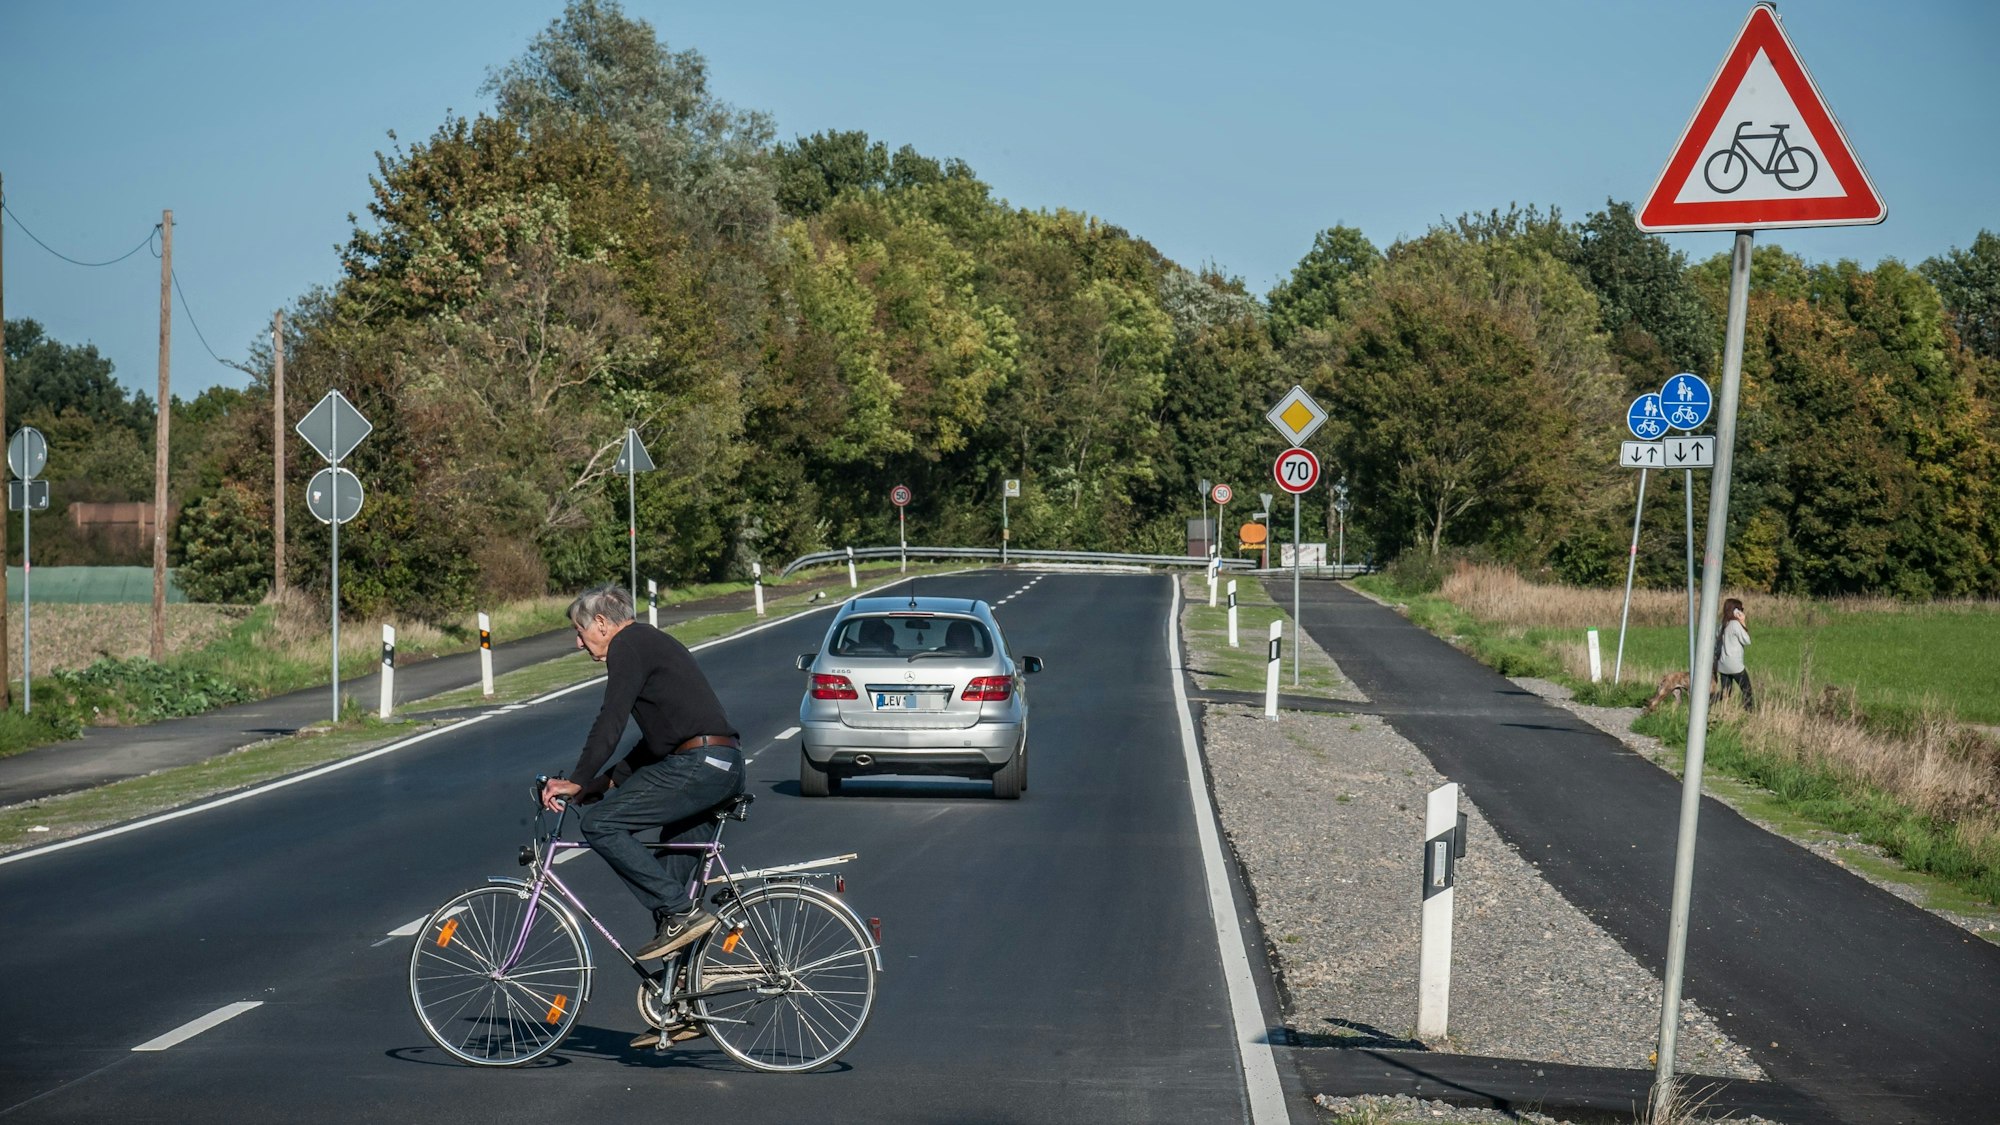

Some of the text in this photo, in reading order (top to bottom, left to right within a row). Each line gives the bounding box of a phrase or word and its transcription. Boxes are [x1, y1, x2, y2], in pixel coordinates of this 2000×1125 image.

[1285, 461, 1309, 481] 70
[896, 491, 907, 500] 50
[1217, 489, 1228, 498] 50
[883, 695, 902, 707] LEV
